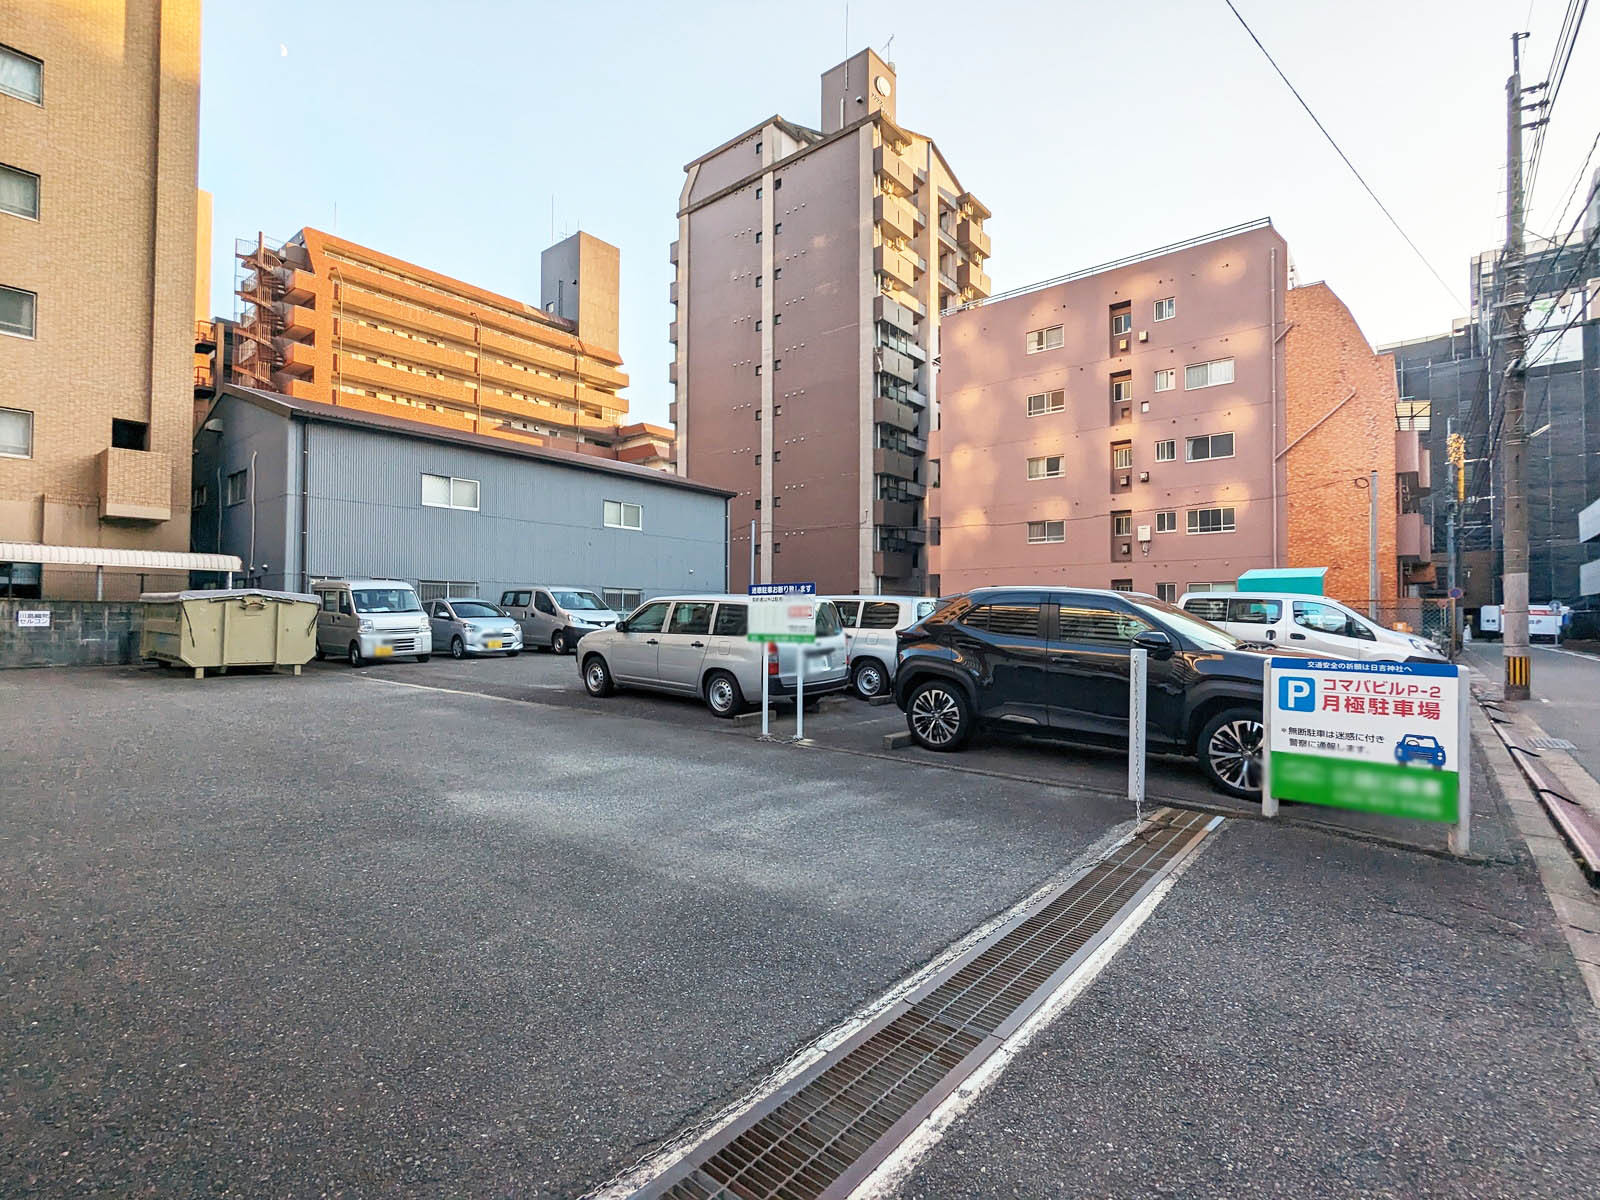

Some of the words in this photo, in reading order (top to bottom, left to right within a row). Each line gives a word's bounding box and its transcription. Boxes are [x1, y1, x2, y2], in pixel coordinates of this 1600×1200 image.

[1287, 680, 1310, 708] P
[1323, 678, 1441, 698] コマバビルP-2
[1322, 695, 1441, 720] 月極駐車場
